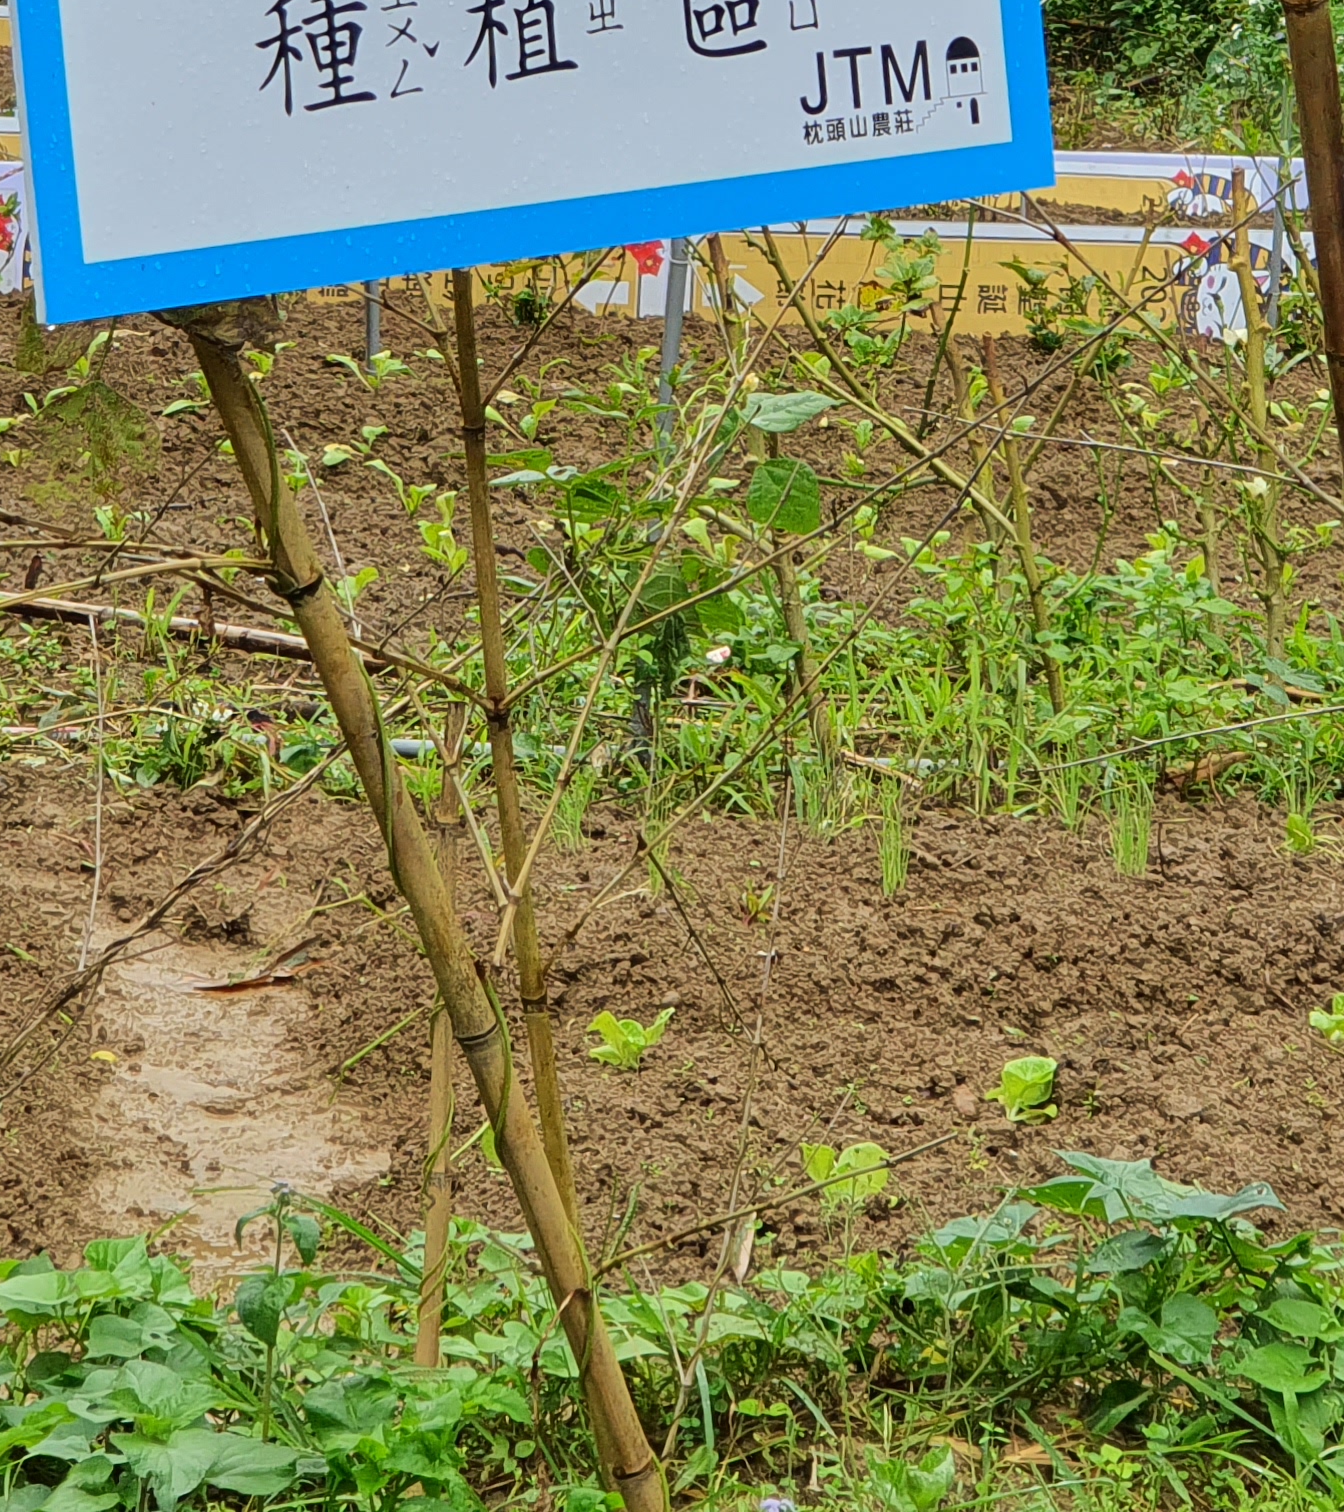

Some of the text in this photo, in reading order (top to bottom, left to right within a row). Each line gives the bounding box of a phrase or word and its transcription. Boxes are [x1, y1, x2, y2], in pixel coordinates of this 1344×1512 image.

[799, 39, 932, 116] JTM
[802, 108, 914, 146] 枕頭山農莊
